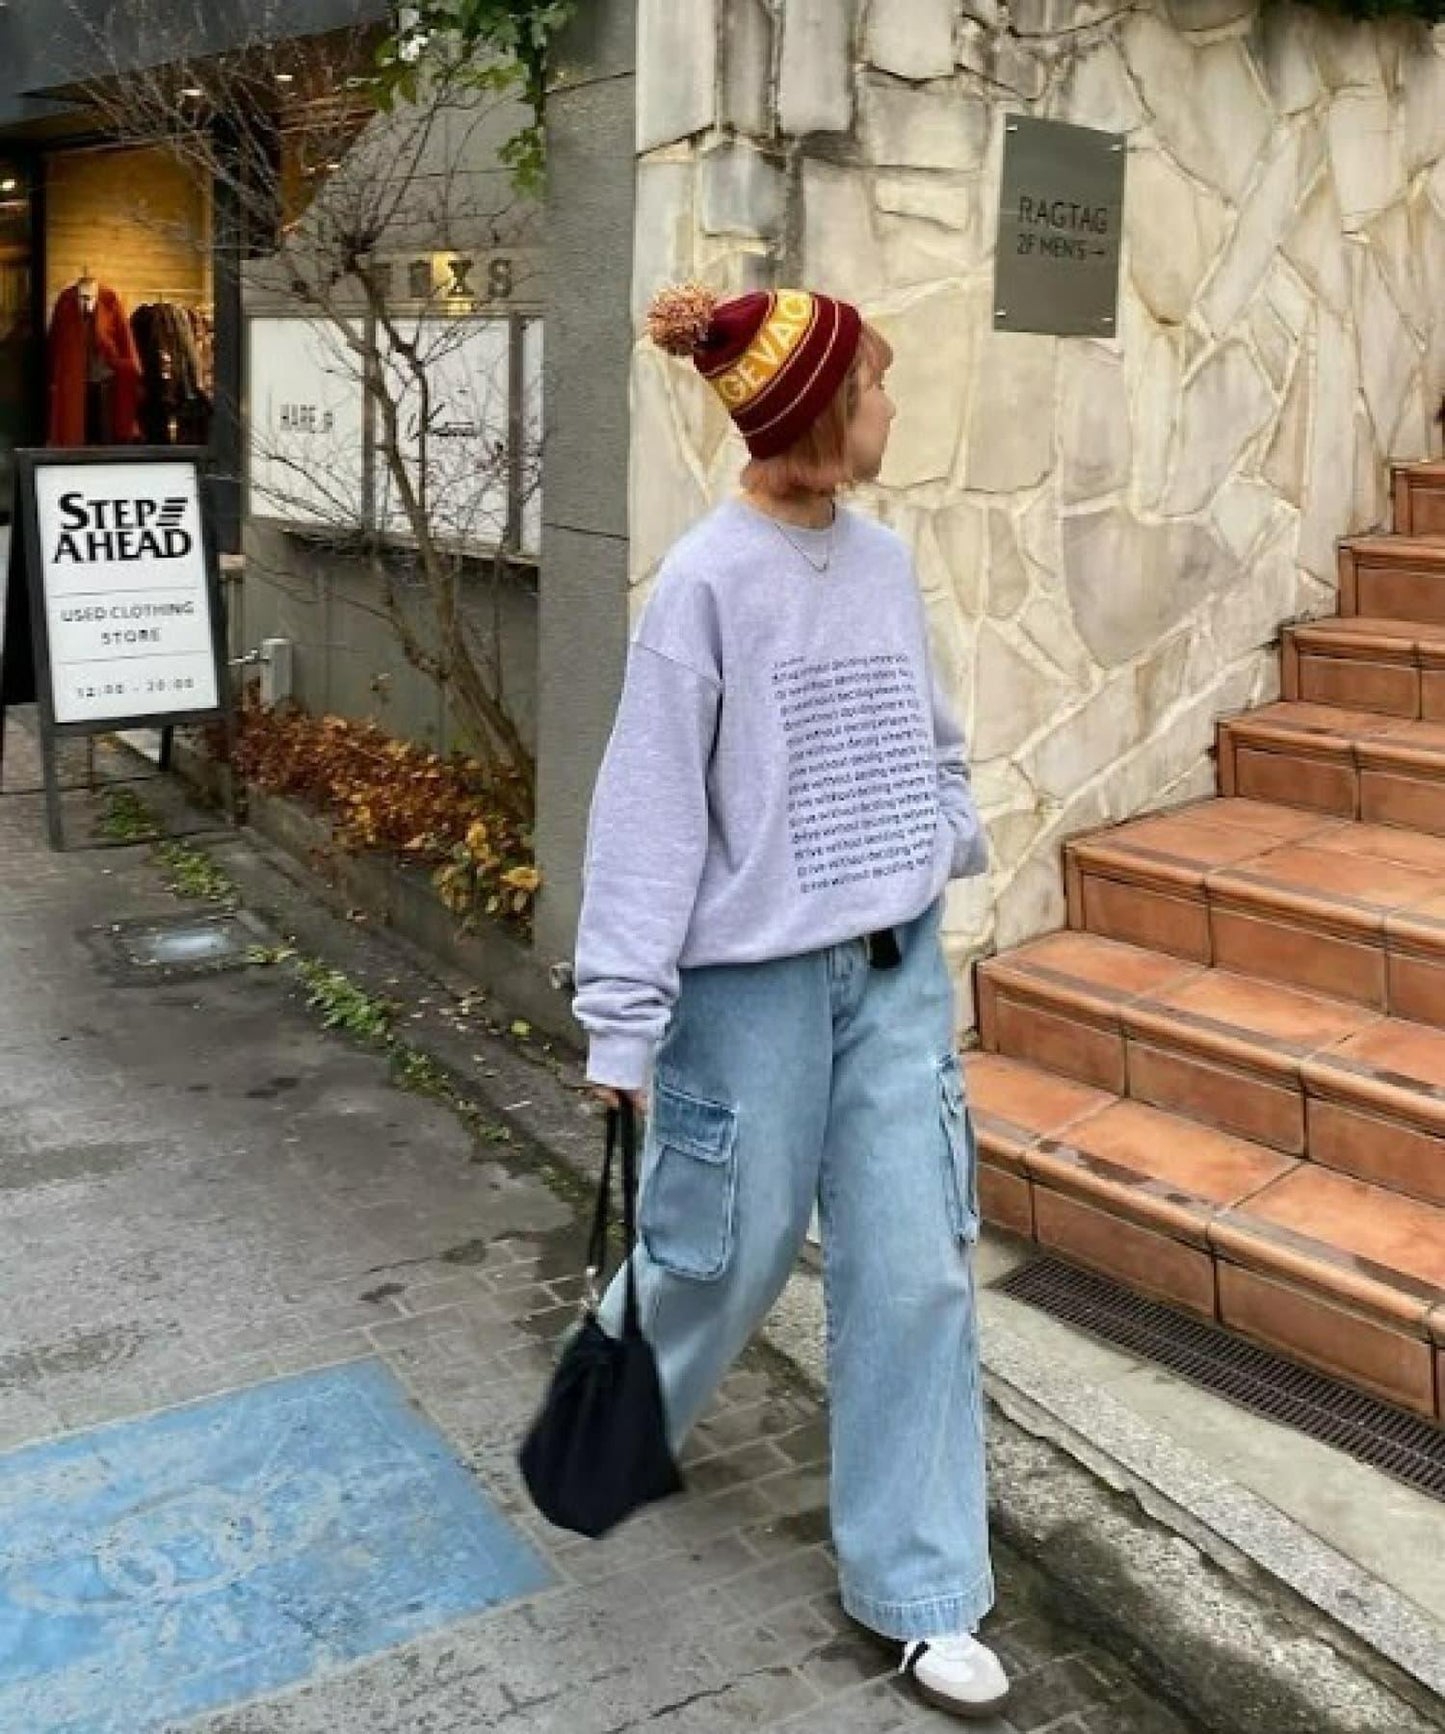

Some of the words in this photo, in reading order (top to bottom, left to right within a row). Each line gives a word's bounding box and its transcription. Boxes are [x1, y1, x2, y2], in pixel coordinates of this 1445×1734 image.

[1019, 196, 1108, 234] RAGTAG
[1017, 233, 1035, 255] 2F
[57, 491, 157, 530] STEP
[51, 528, 192, 564] AHEAD
[61, 606, 107, 622] USED
[109, 600, 195, 620] CLOTHING
[101, 627, 161, 645] STORE
